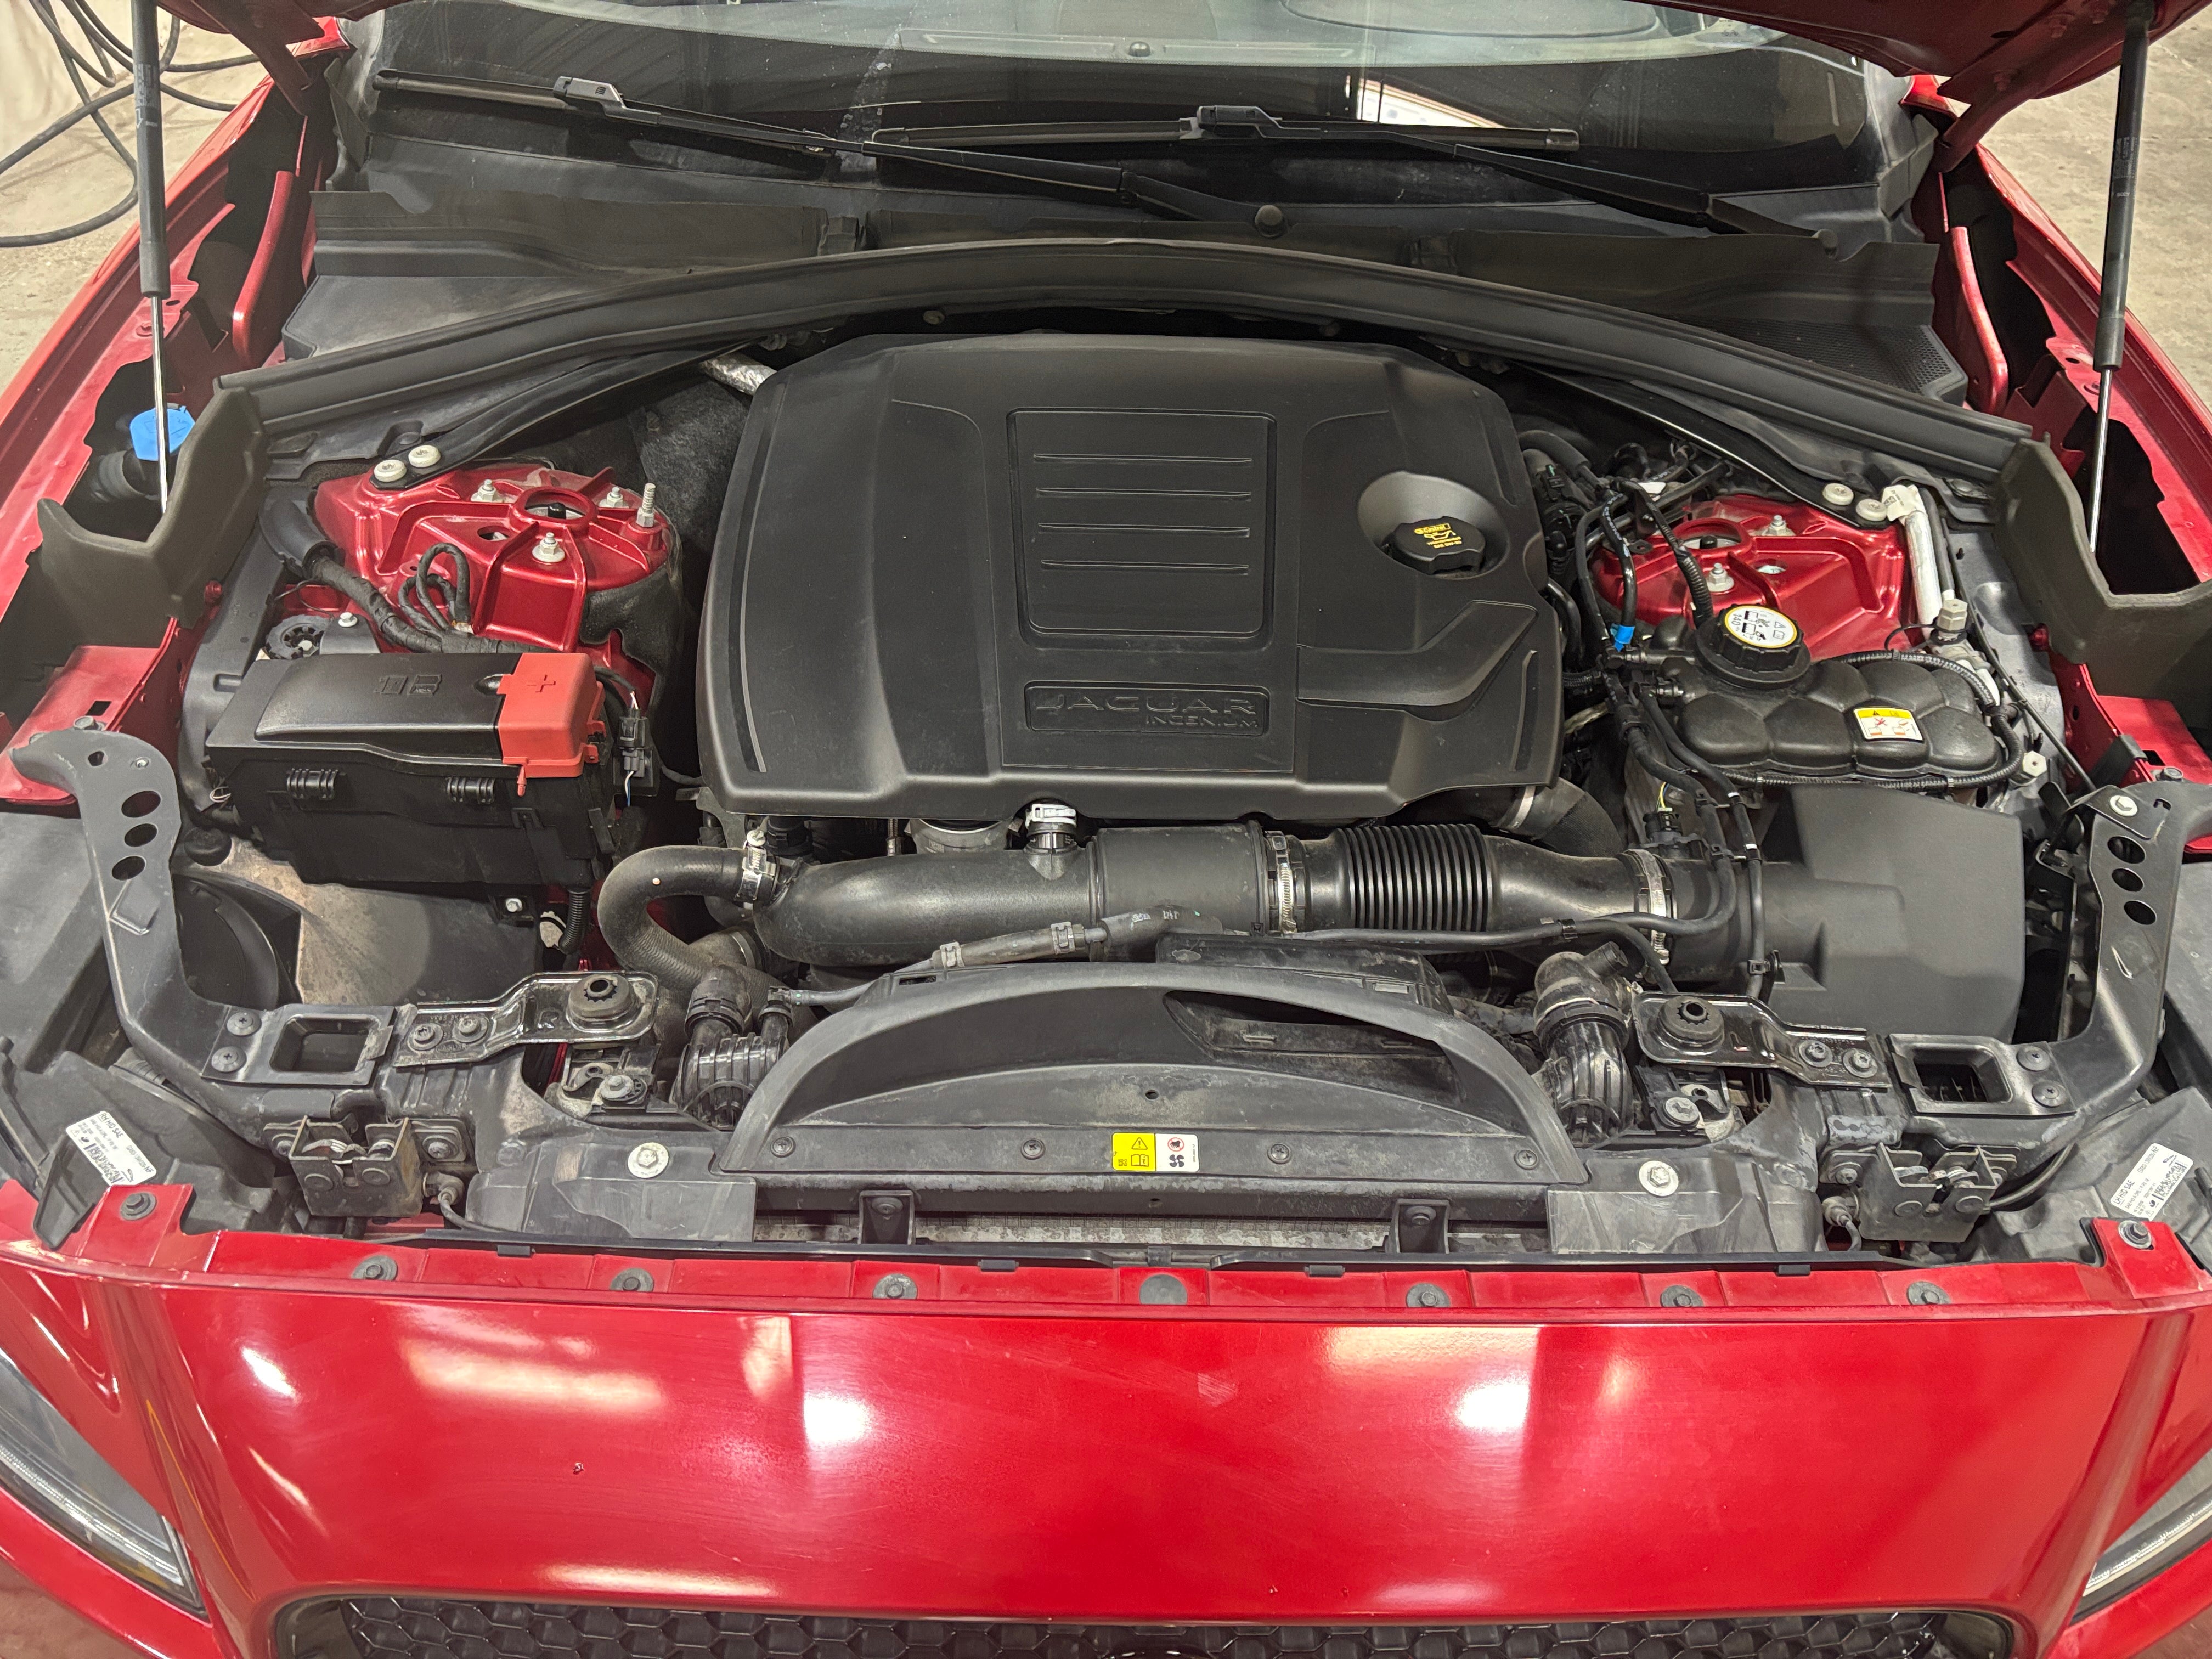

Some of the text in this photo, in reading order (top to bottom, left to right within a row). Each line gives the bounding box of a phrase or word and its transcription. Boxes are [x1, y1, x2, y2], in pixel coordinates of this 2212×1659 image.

[1731, 614, 1742, 626] 140
[1036, 695, 1257, 715] JAGUAR
[1146, 714, 1259, 728] INGENIUM
[100, 1113, 110, 1121] RH
[105, 1120, 116, 1129] HID
[112, 1128, 124, 1138] SAE
[2118, 1188, 2128, 1198] HID
[2124, 1180, 2135, 1190] SAE
